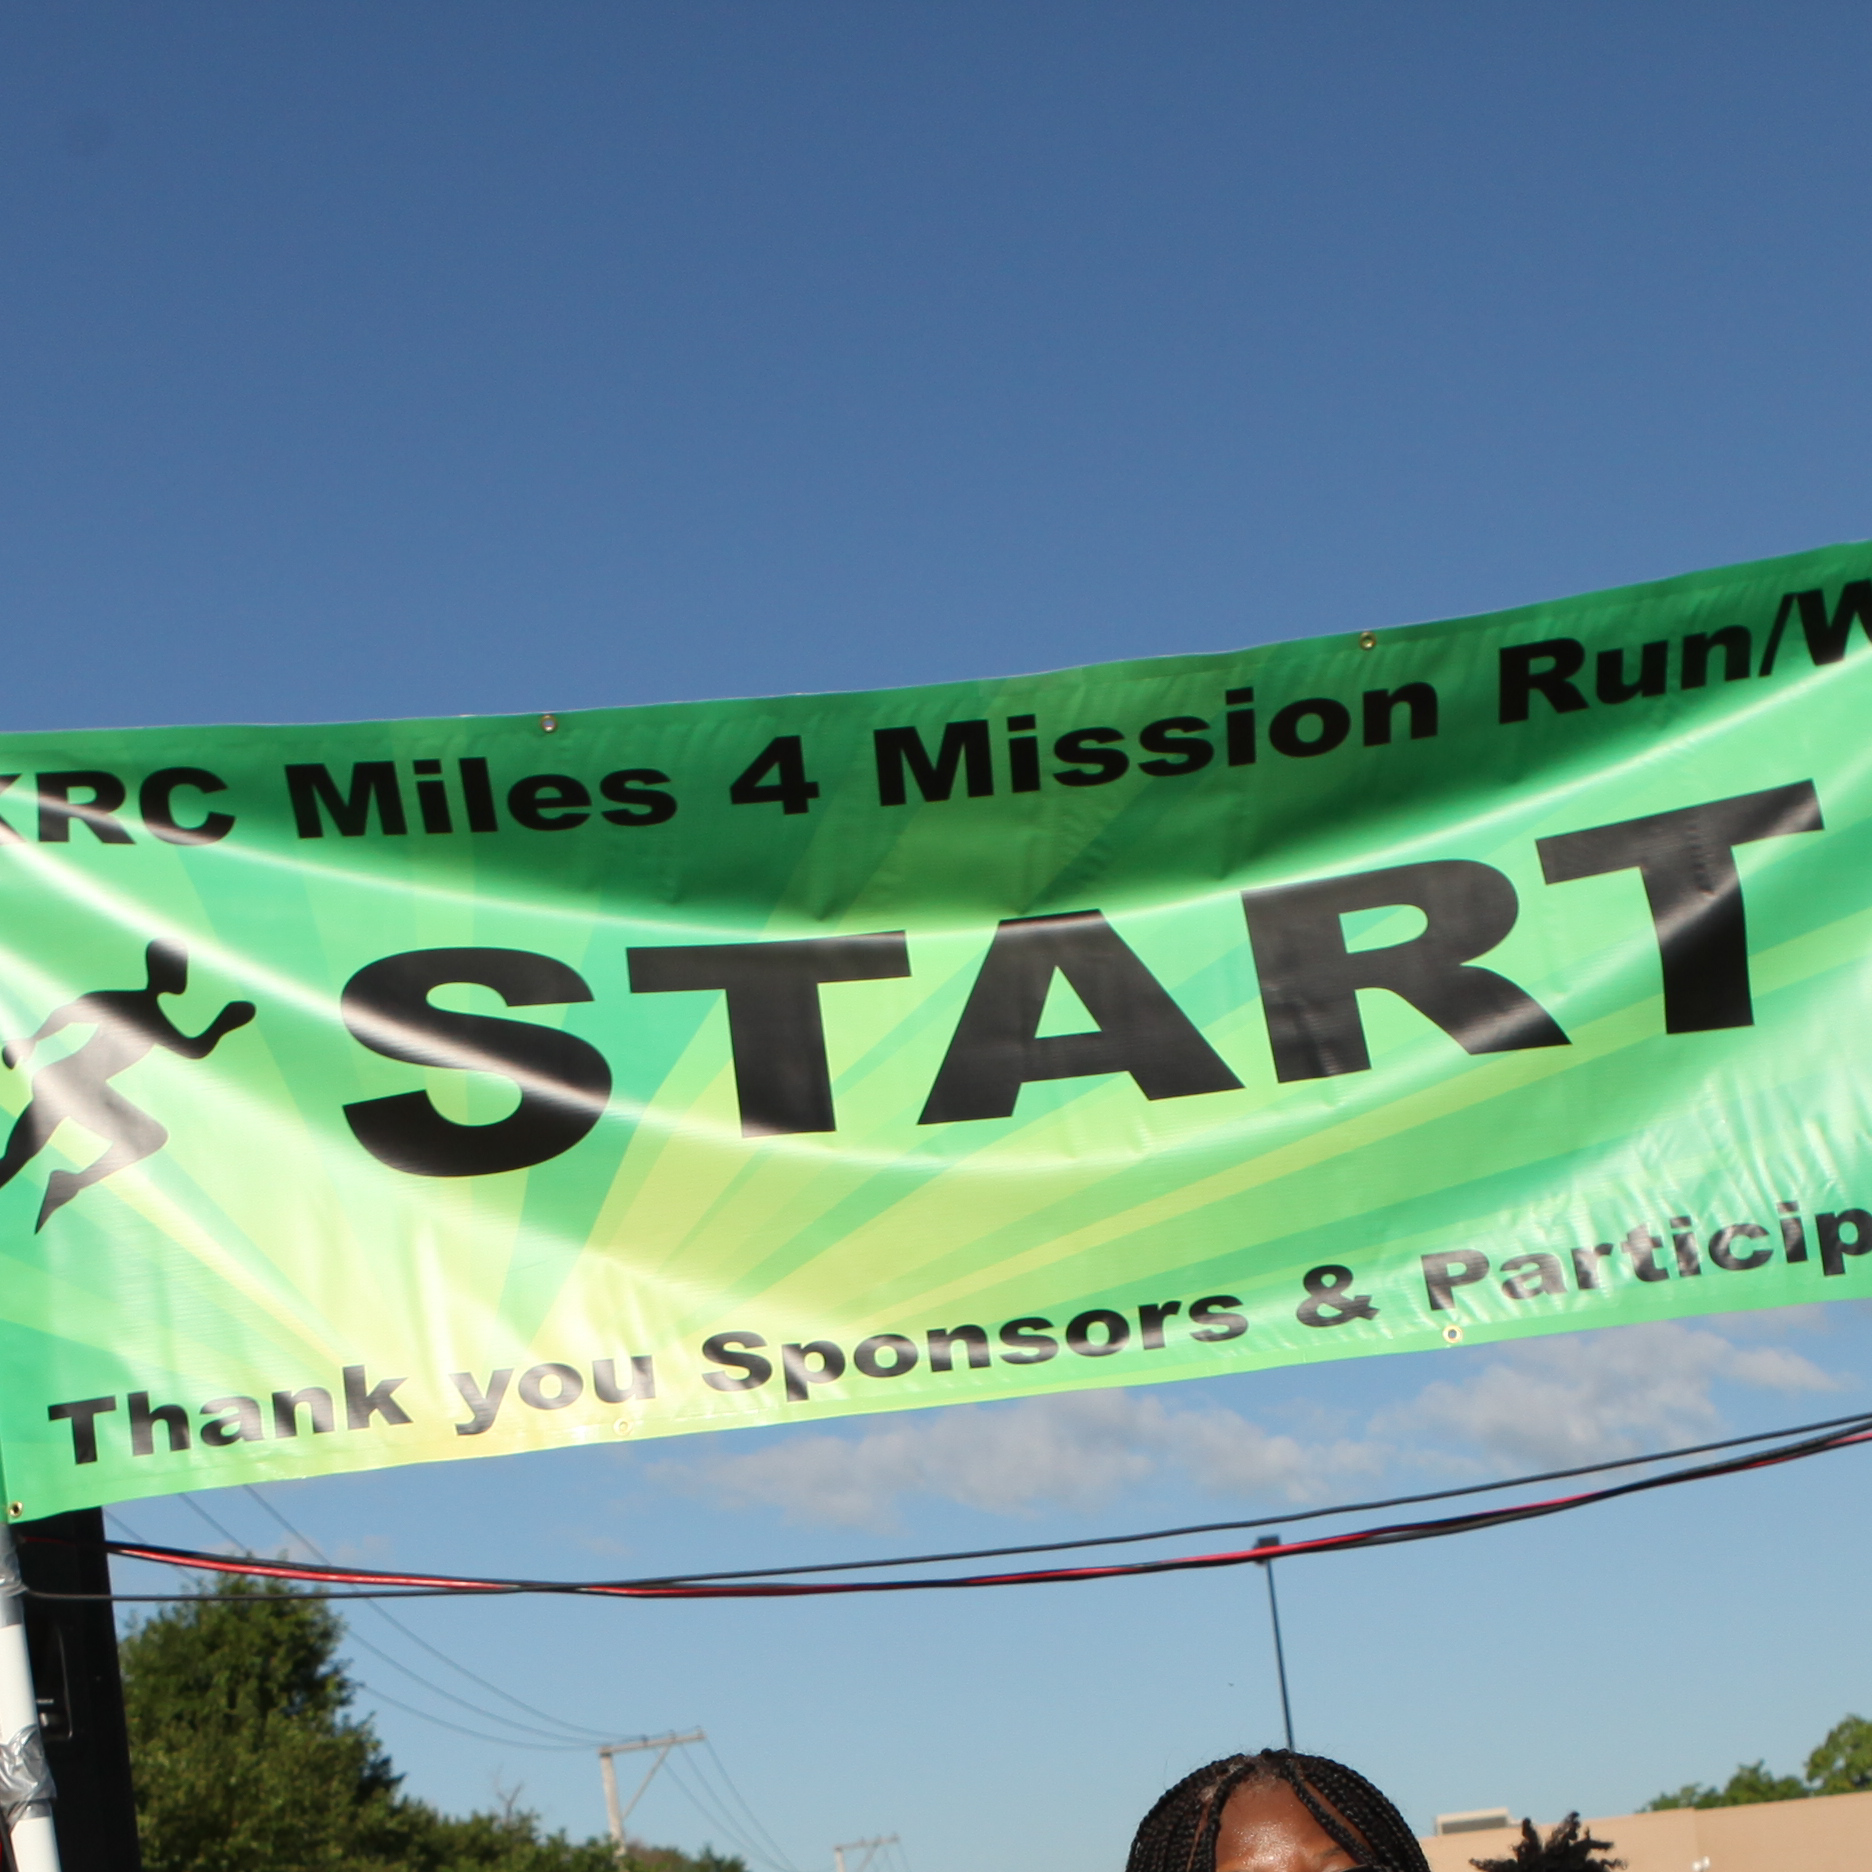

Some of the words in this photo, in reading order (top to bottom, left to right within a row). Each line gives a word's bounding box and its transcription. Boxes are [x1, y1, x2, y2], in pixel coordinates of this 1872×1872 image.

[284, 756, 677, 840] Miles
[729, 734, 820, 816] 4
[872, 680, 1439, 808] Mission
[340, 779, 1826, 1178] START
[48, 1364, 414, 1466] Thank
[449, 1354, 658, 1437] you
[701, 1294, 1250, 1403] Sponsors
[1295, 1263, 1381, 1328] &
